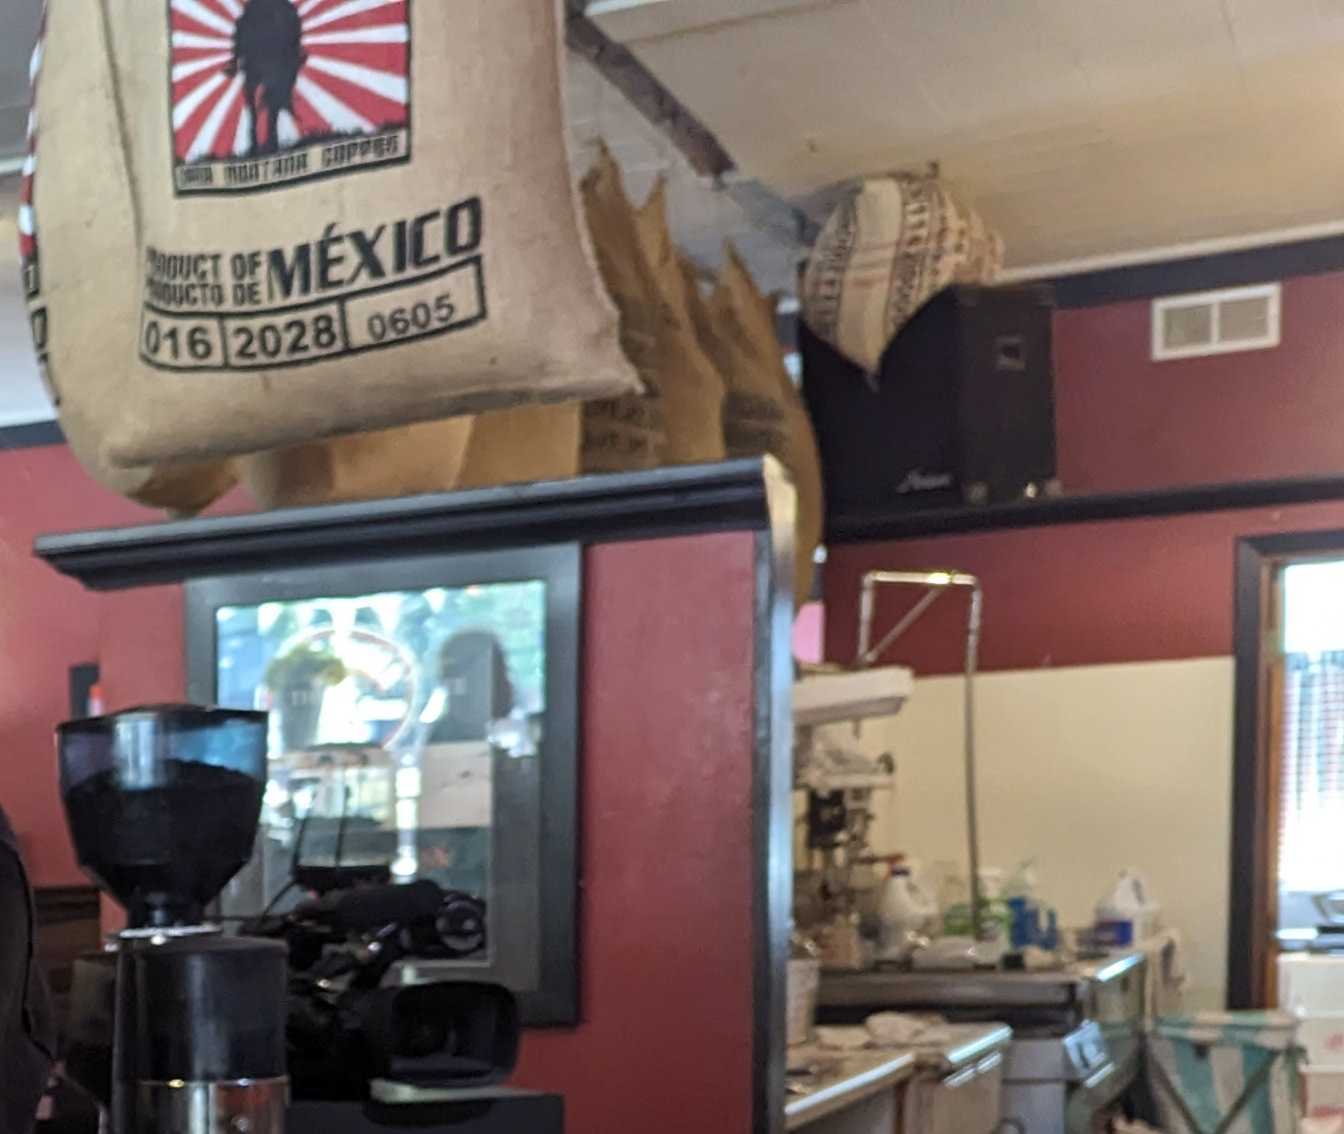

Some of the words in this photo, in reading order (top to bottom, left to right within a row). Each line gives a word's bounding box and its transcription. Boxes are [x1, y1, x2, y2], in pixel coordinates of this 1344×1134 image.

[231, 250, 261, 280] OF
[267, 197, 482, 303] MÉXICO
[233, 281, 261, 305] DE
[233, 313, 337, 359] 2028
[367, 294, 456, 342] 0605
